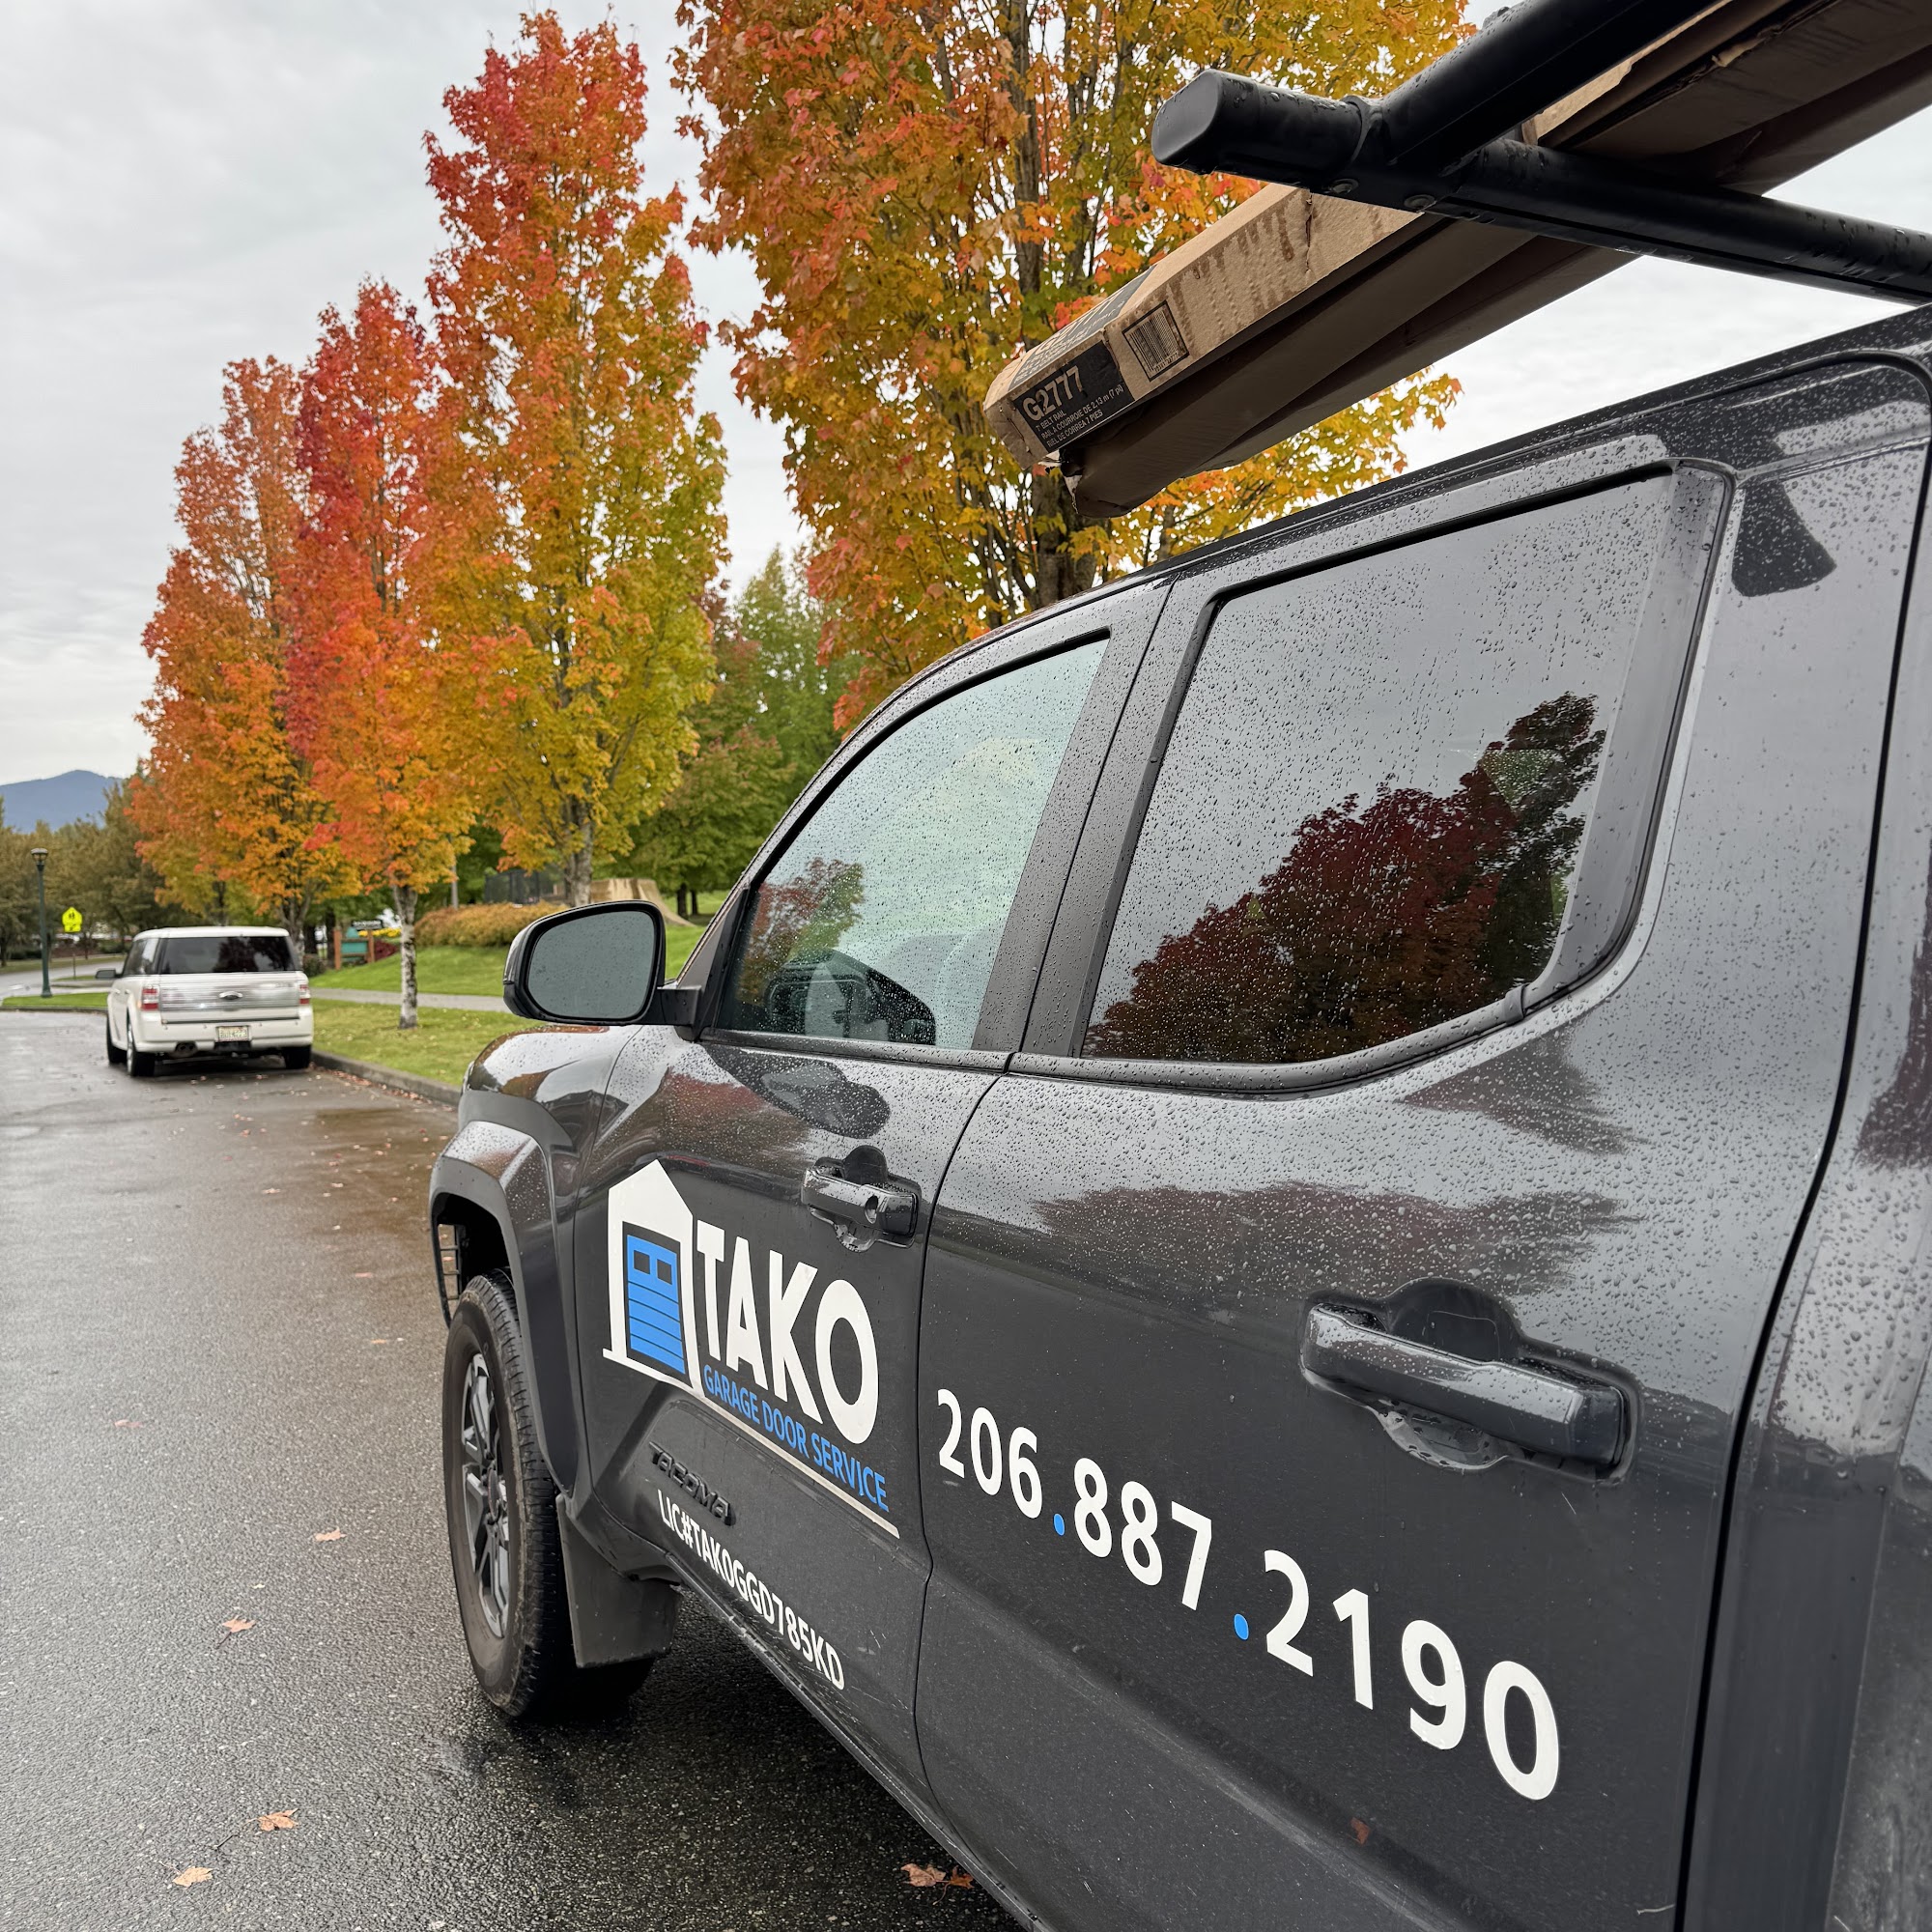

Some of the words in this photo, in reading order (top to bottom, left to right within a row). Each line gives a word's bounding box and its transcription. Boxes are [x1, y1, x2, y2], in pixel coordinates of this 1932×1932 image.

[1023, 365, 1083, 421] G2777
[1041, 428, 1054, 440] RAIL
[1057, 410, 1085, 430] COURROIE
[1084, 404, 1094, 414] DE
[1042, 416, 1055, 429] BELT
[1053, 410, 1066, 421] RAIL
[1058, 431, 1066, 440] DE
[1065, 419, 1087, 438] CORREA
[1090, 410, 1103, 422] PIES
[696, 1220, 879, 1444] TAKO
[703, 1364, 760, 1425] GARAGE
[762, 1400, 810, 1459] DOOR
[810, 1433, 890, 1513] SERVICE
[649, 1440, 735, 1526] TACOMA
[937, 1388, 1559, 1801] 206.887.2190
